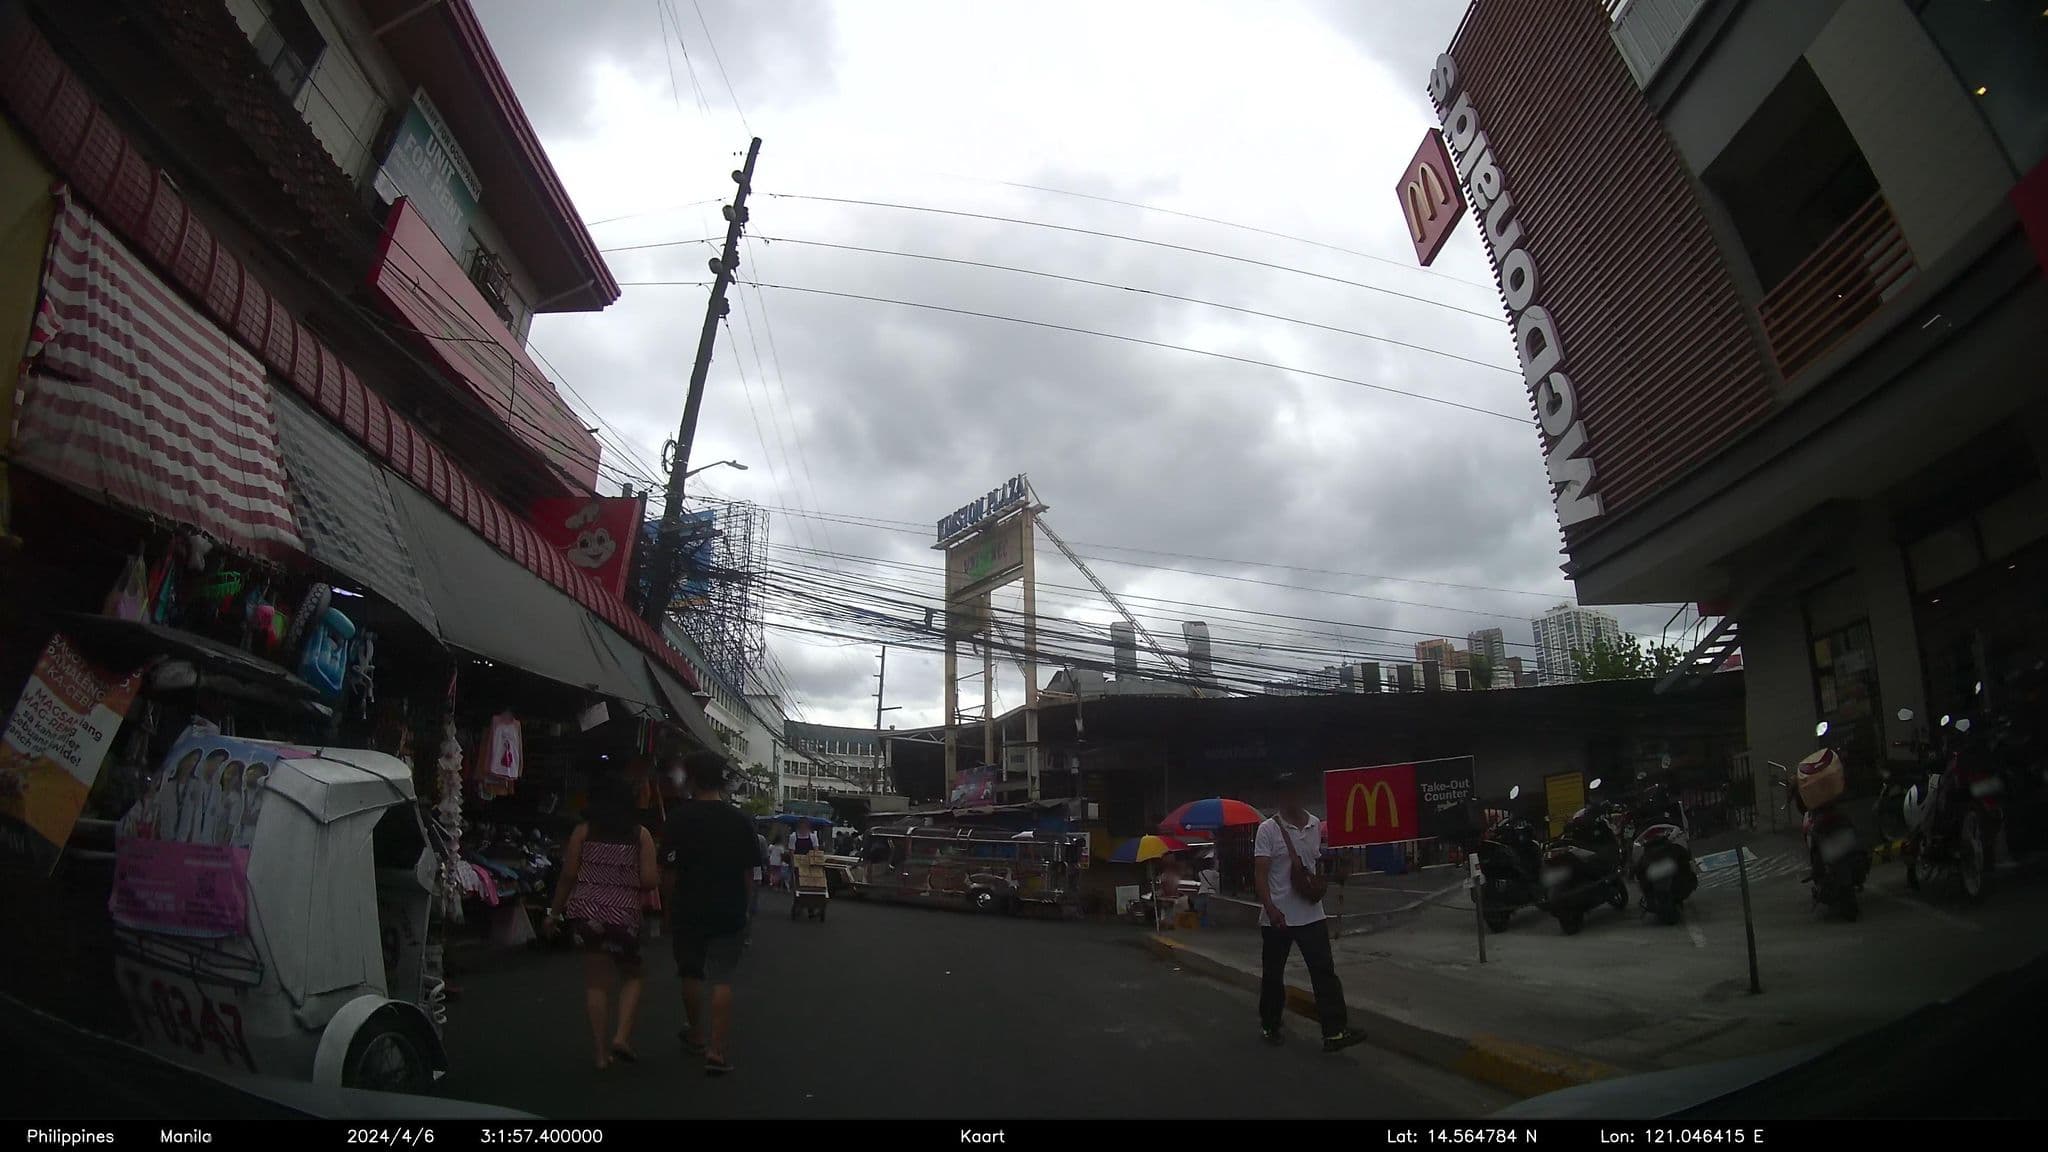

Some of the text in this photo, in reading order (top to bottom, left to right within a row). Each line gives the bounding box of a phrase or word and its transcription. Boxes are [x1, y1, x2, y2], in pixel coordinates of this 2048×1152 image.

[404, 134, 432, 178] FOR
[426, 134, 455, 183] UNIT
[1421, 779, 1471, 794] Take-Out
[1424, 789, 1469, 802] Counter
